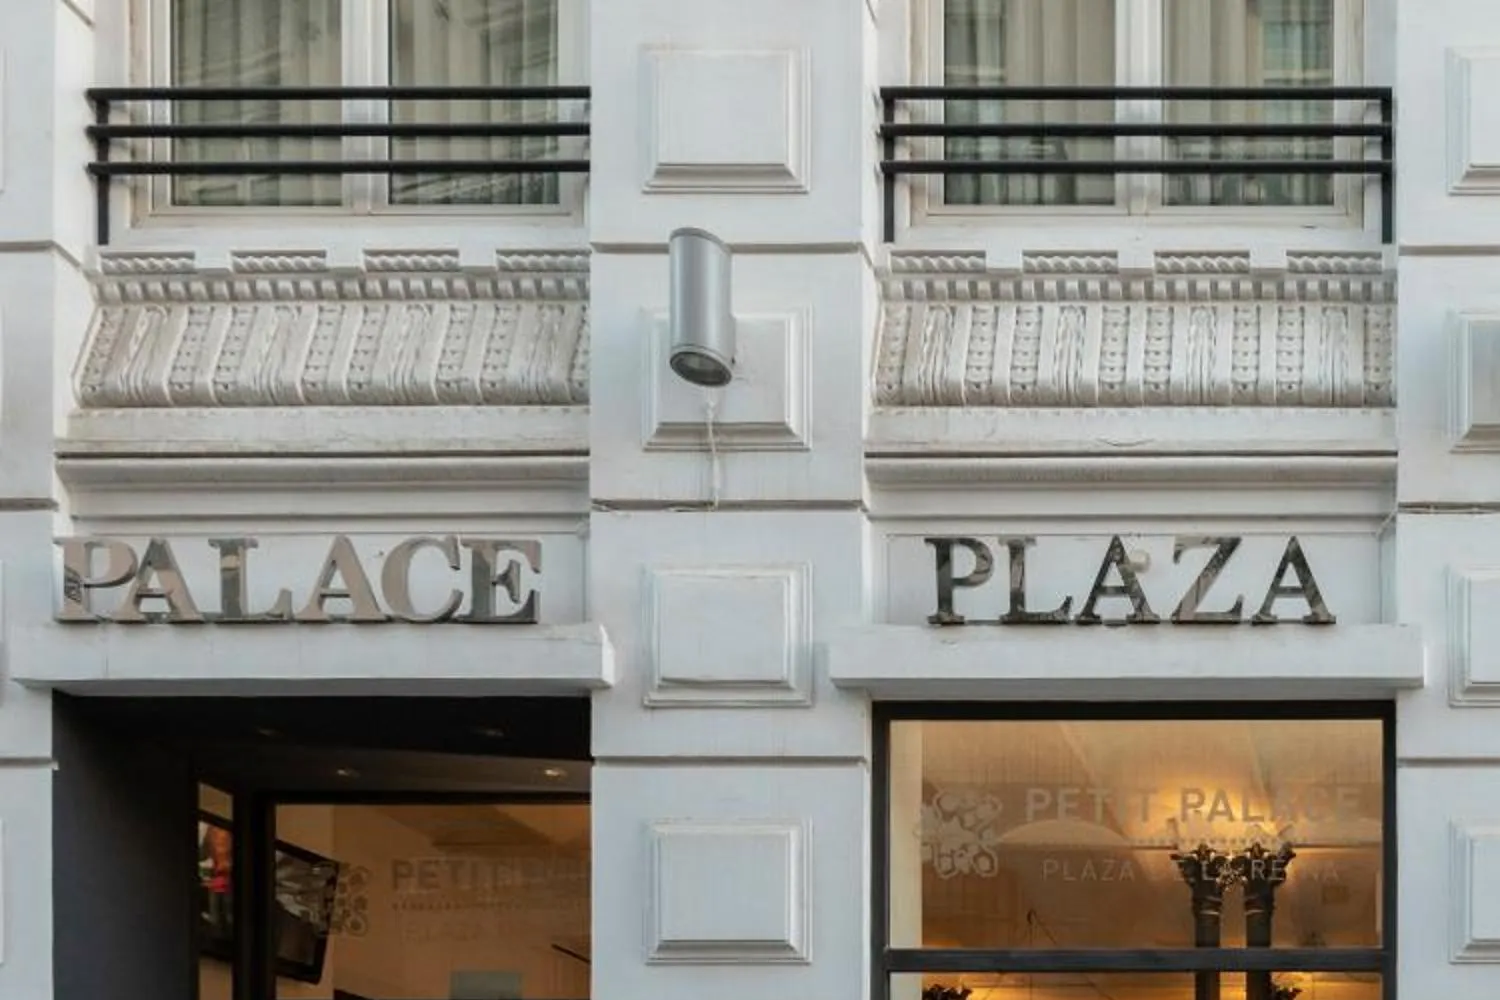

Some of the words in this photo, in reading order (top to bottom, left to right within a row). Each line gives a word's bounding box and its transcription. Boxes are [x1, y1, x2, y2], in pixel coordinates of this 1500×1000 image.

[53, 534, 543, 625] PALACE
[925, 534, 1337, 626] PLAZA
[1026, 787, 1158, 823] PETIT
[1180, 787, 1362, 823] PALACE
[1041, 857, 1136, 882] PLAZA
